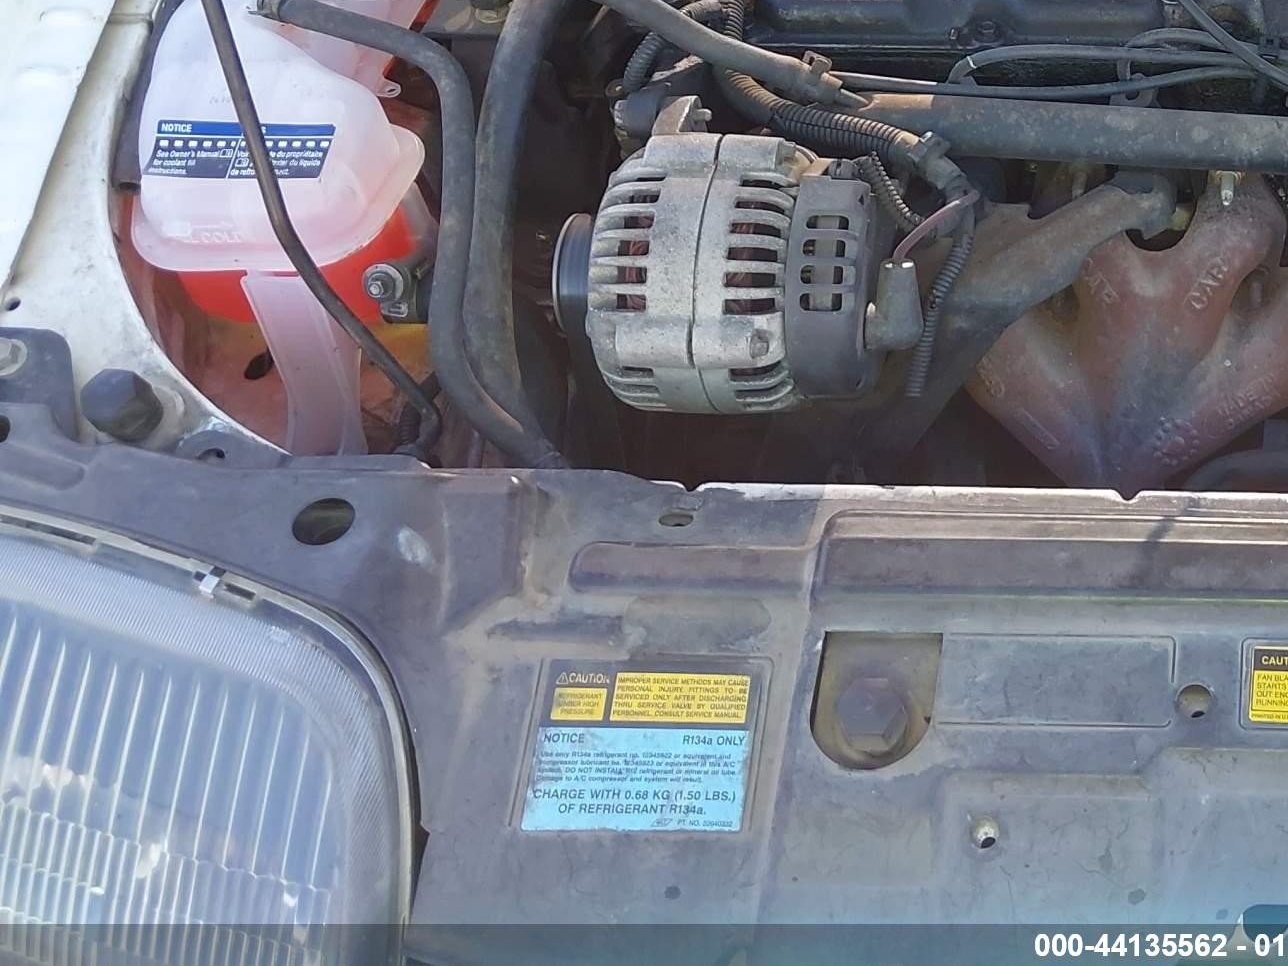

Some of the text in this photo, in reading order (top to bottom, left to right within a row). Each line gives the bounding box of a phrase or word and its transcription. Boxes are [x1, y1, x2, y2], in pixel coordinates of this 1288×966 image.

[161, 124, 192, 134] NOTICE
[156, 150, 170, 158] See
[568, 672, 610, 684] CAUTION
[1256, 674, 1272, 682] FAN
[1256, 682, 1286, 690] STARTS
[1256, 690, 1274, 698] OUT
[686, 710, 712, 718] SERVICE
[544, 733, 745, 746] NOTICE R134a ONLY
[534, 789, 736, 802] CHARGE WITH 0.68 KG (1.50 LBS.)
[558, 803, 706, 816] OF REFRIGERANT R134a.
